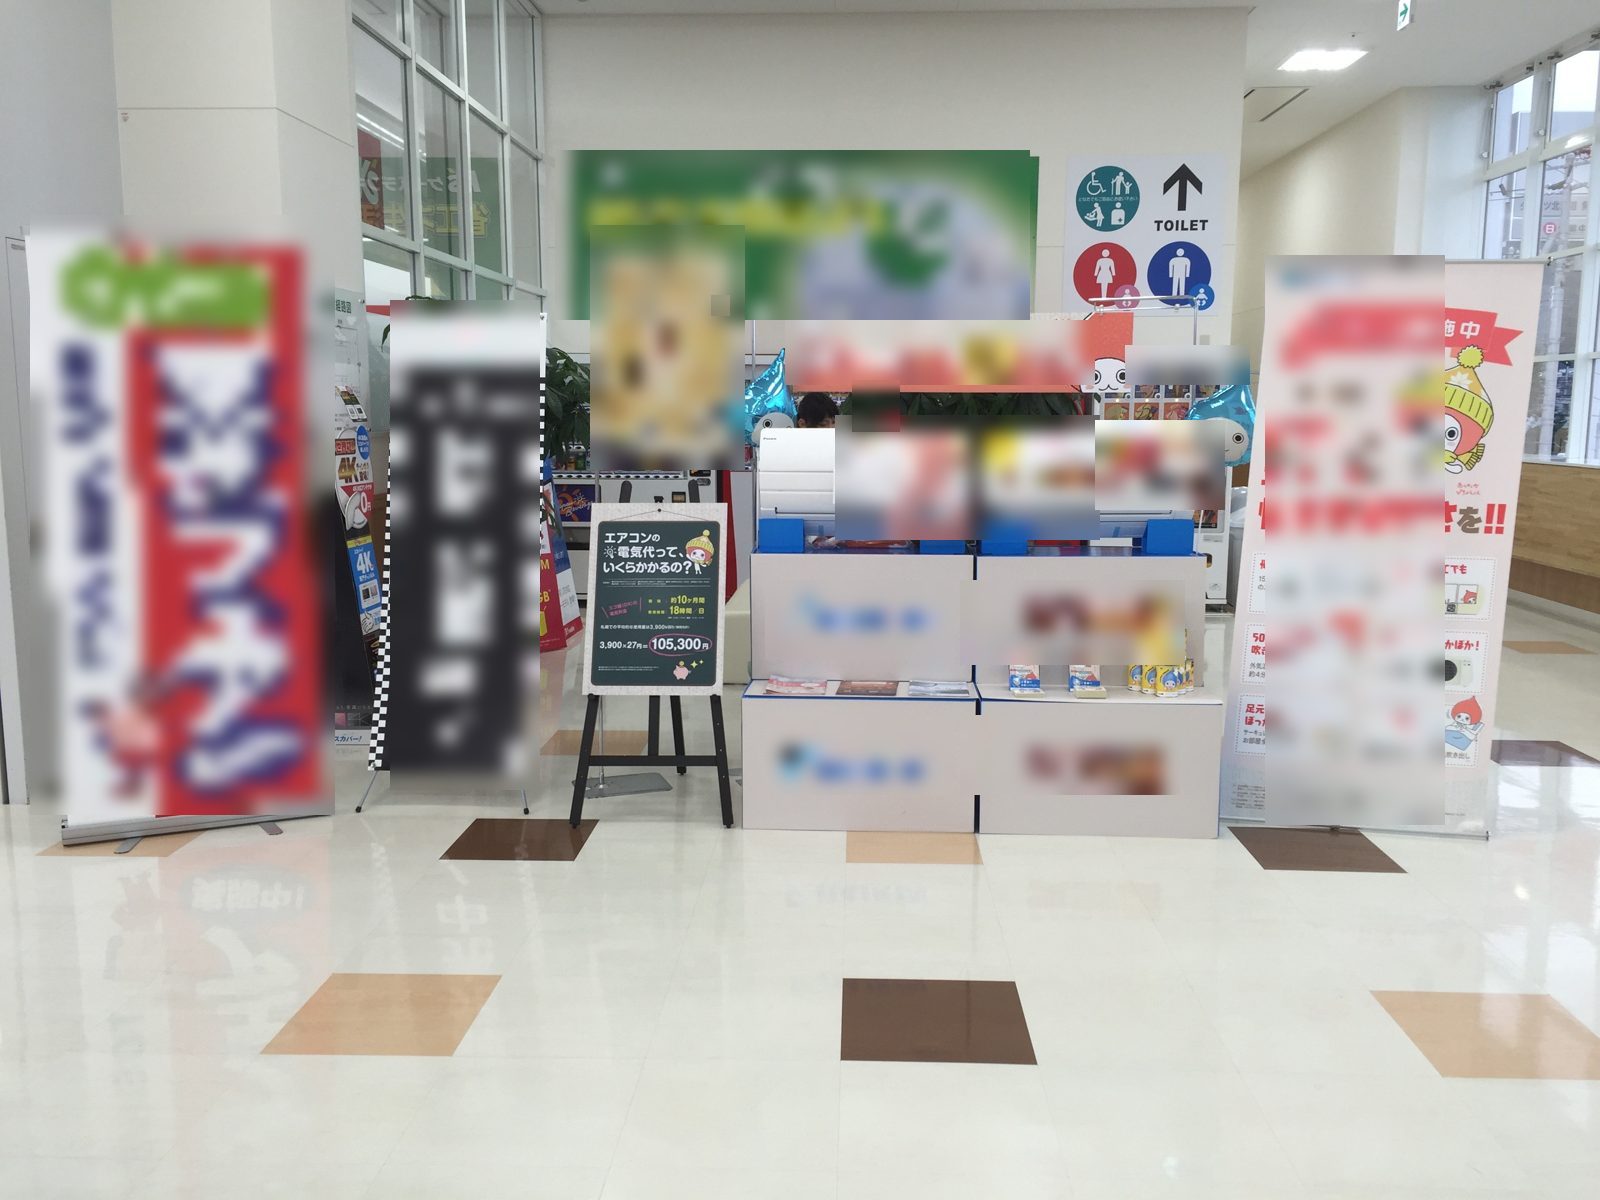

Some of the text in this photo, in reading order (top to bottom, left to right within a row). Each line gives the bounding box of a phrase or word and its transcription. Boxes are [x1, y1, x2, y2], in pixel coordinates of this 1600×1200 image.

[1154, 220, 1209, 231] TOILET
[338, 457, 358, 483] 4K
[604, 532, 660, 544] エアコンの
[617, 545, 684, 559] 電気代って、
[356, 550, 374, 574] 4K
[602, 560, 692, 575] いくらかかるの?
[651, 638, 709, 651] 105,300円
[1245, 703, 1265, 714] 足元
